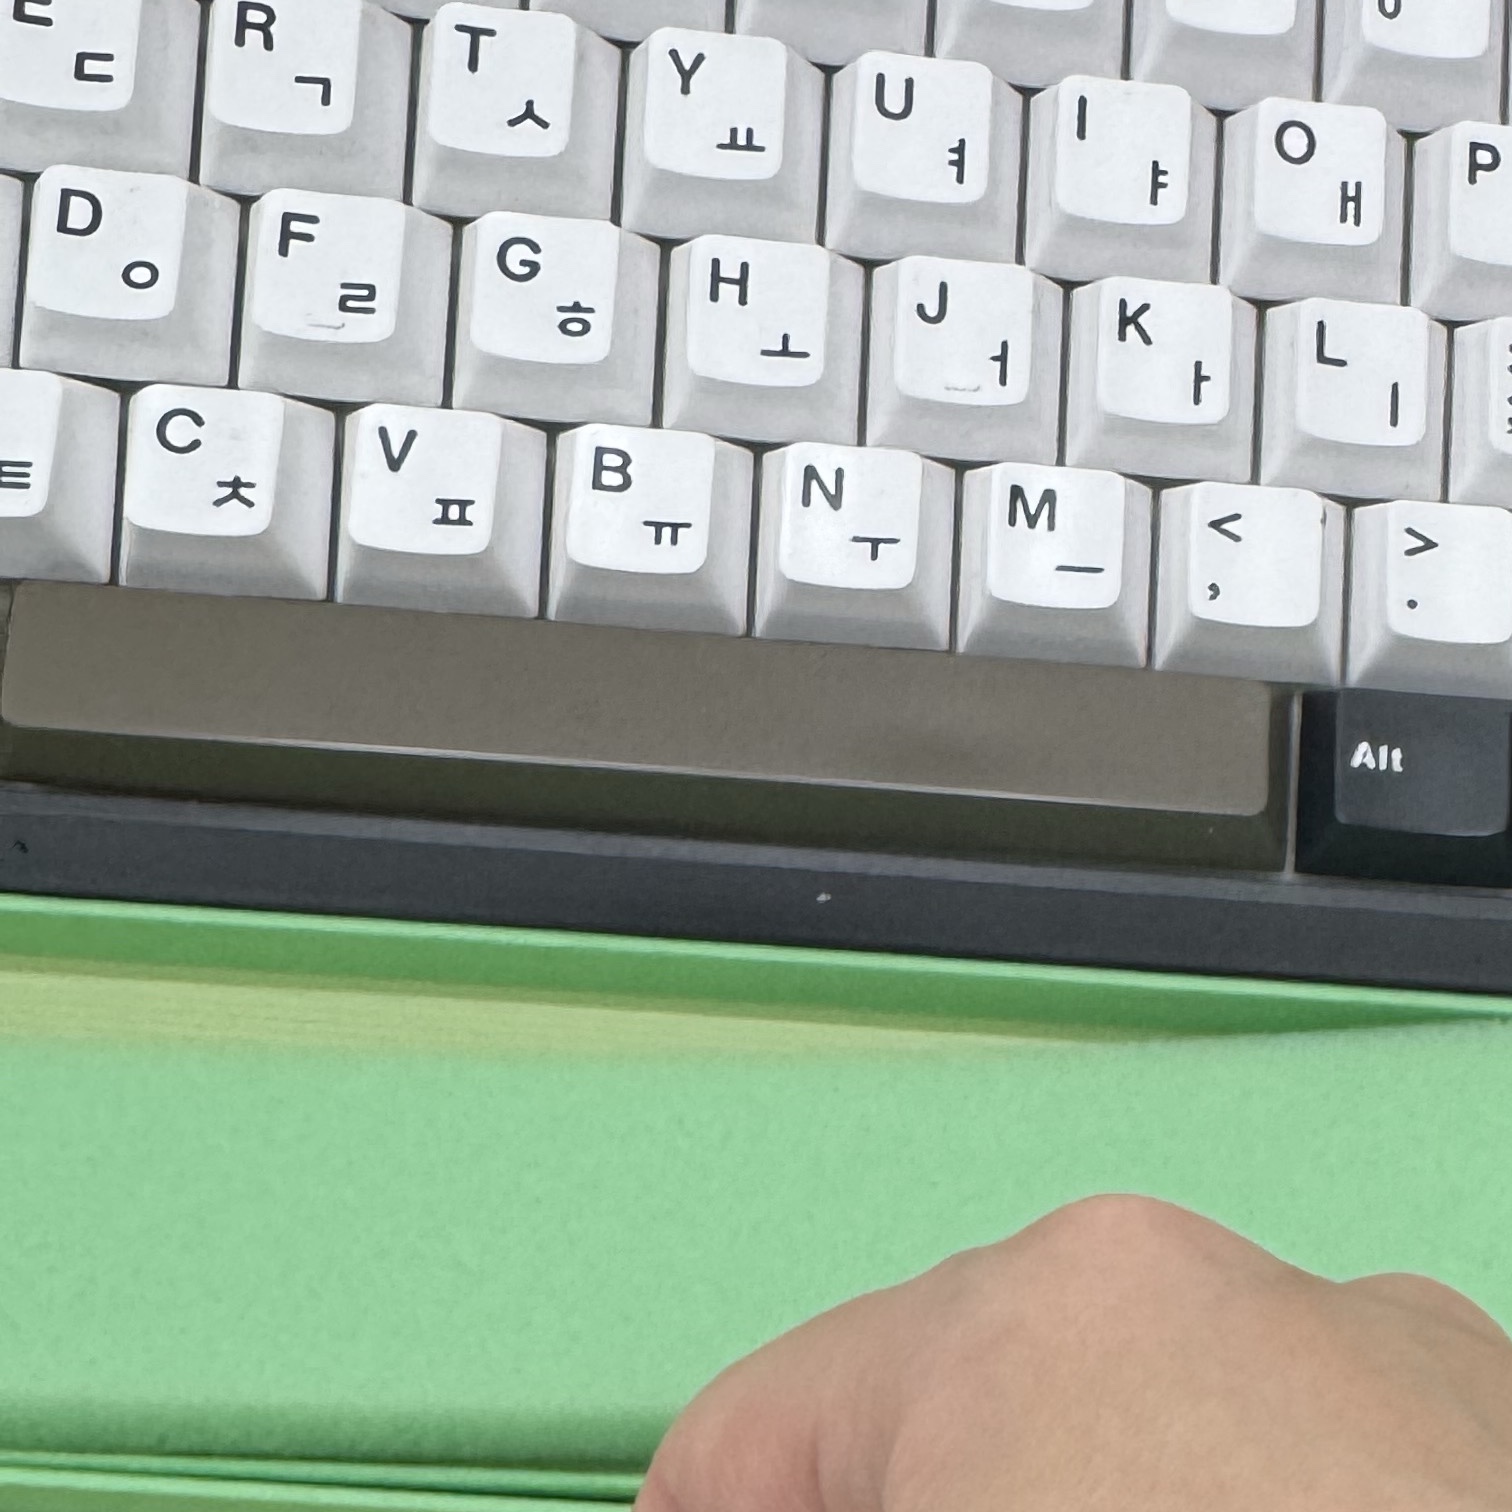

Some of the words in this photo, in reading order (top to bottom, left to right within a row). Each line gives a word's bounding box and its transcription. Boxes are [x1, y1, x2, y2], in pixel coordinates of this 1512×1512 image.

[234, 0, 277, 52] R
[453, 23, 497, 74] T
[73, 51, 115, 83] ㄷ
[668, 48, 706, 96] Y
[294, 75, 332, 107] ㄱ
[506, 99, 551, 130] ㅅ
[874, 72, 915, 121] U
[715, 126, 766, 153] ㅛ
[1076, 94, 1088, 141] I
[947, 137, 966, 185] ㅕ
[1274, 119, 1317, 166] O
[1467, 141, 1502, 186] P
[1149, 159, 1169, 207] ㅑ
[1339, 180, 1362, 228] ㅐ
[56, 187, 103, 237] D
[277, 211, 321, 258] F
[121, 260, 160, 290] ㅇ
[496, 236, 542, 283] G
[709, 257, 750, 307] H
[337, 282, 377, 315] ㄹ
[556, 300, 596, 338] ㅎ
[916, 280, 948, 325] J
[1117, 297, 1153, 346] K
[760, 332, 811, 359] ㅗ
[989, 339, 1009, 387] ㅓ
[1315, 319, 1348, 368] L
[1192, 360, 1212, 406] ㅏ
[155, 407, 206, 455] C
[377, 425, 418, 473] V
[212, 475, 257, 509] ㅊ
[591, 445, 633, 493] B
[801, 464, 845, 512] N
[432, 497, 476, 527] ㅍ
[1007, 483, 1057, 532] M
[1207, 512, 1243, 543] <
[642, 520, 693, 547] ㅠ
[850, 535, 901, 562] ㅜ
[1403, 526, 1439, 557] >
[1350, 741, 1403, 773] Alt
